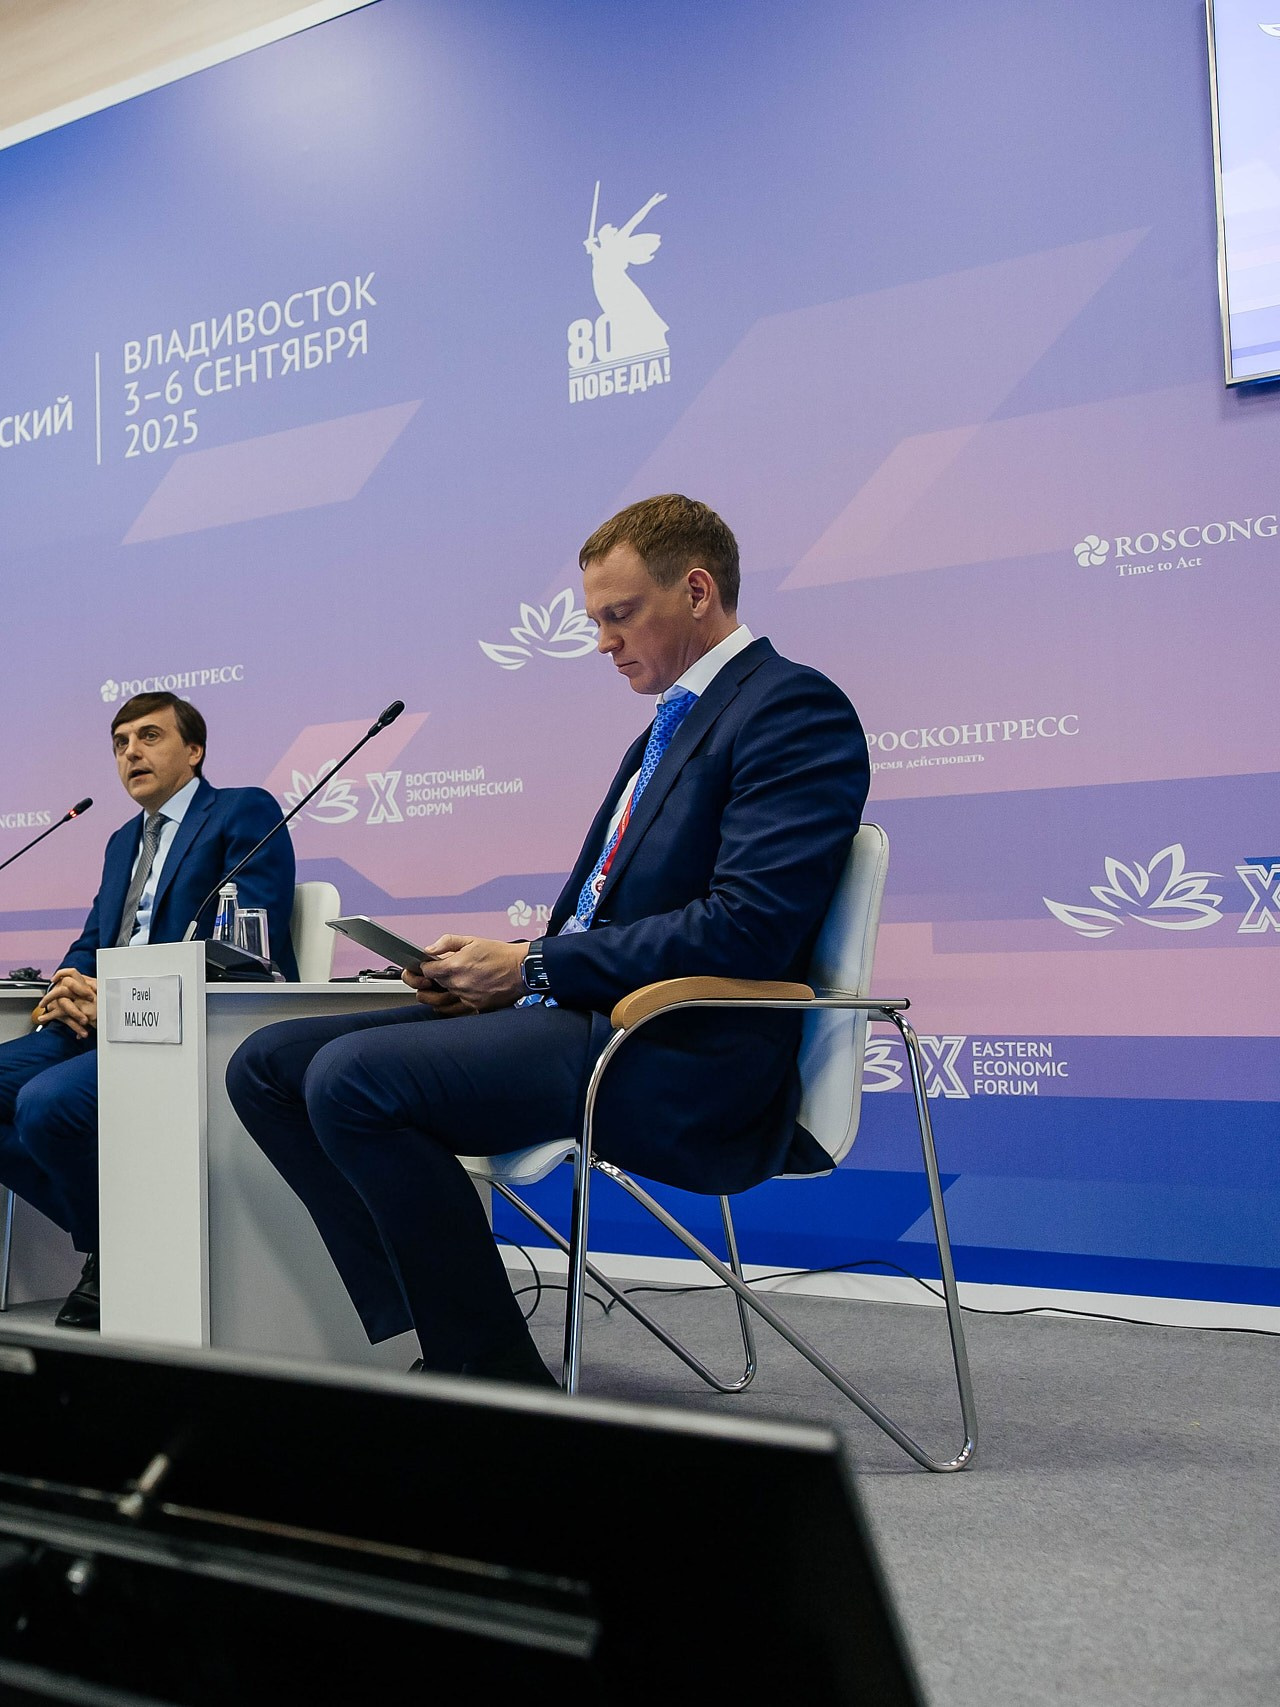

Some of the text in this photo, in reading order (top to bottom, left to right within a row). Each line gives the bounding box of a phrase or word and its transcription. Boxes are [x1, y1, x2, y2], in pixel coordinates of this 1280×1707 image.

[124, 272, 377, 374] ВЛАДИВОСТОК
[568, 313, 619, 369] 80
[193, 319, 367, 397] СЕНТЯБРЯ
[569, 357, 670, 404] ПОБЕДА!
[124, 408, 198, 458] 2025
[1115, 557, 1202, 577] Time to Act
[121, 664, 244, 697] РОСКОНГРЕСС
[870, 753, 985, 774] ремя действовать
[406, 765, 485, 787] ВОСТОЧНЫЙ
[406, 779, 523, 803] ЭКОНОМИЧЕСКИЙ
[406, 802, 452, 818] ФОРУМ
[132, 987, 151, 1001] Pavel
[124, 1011, 160, 1027] MALKOV
[972, 1041, 1052, 1058] EASTERN
[973, 1061, 1069, 1077] ECONOMIC
[974, 1079, 1038, 1096] FORUM
